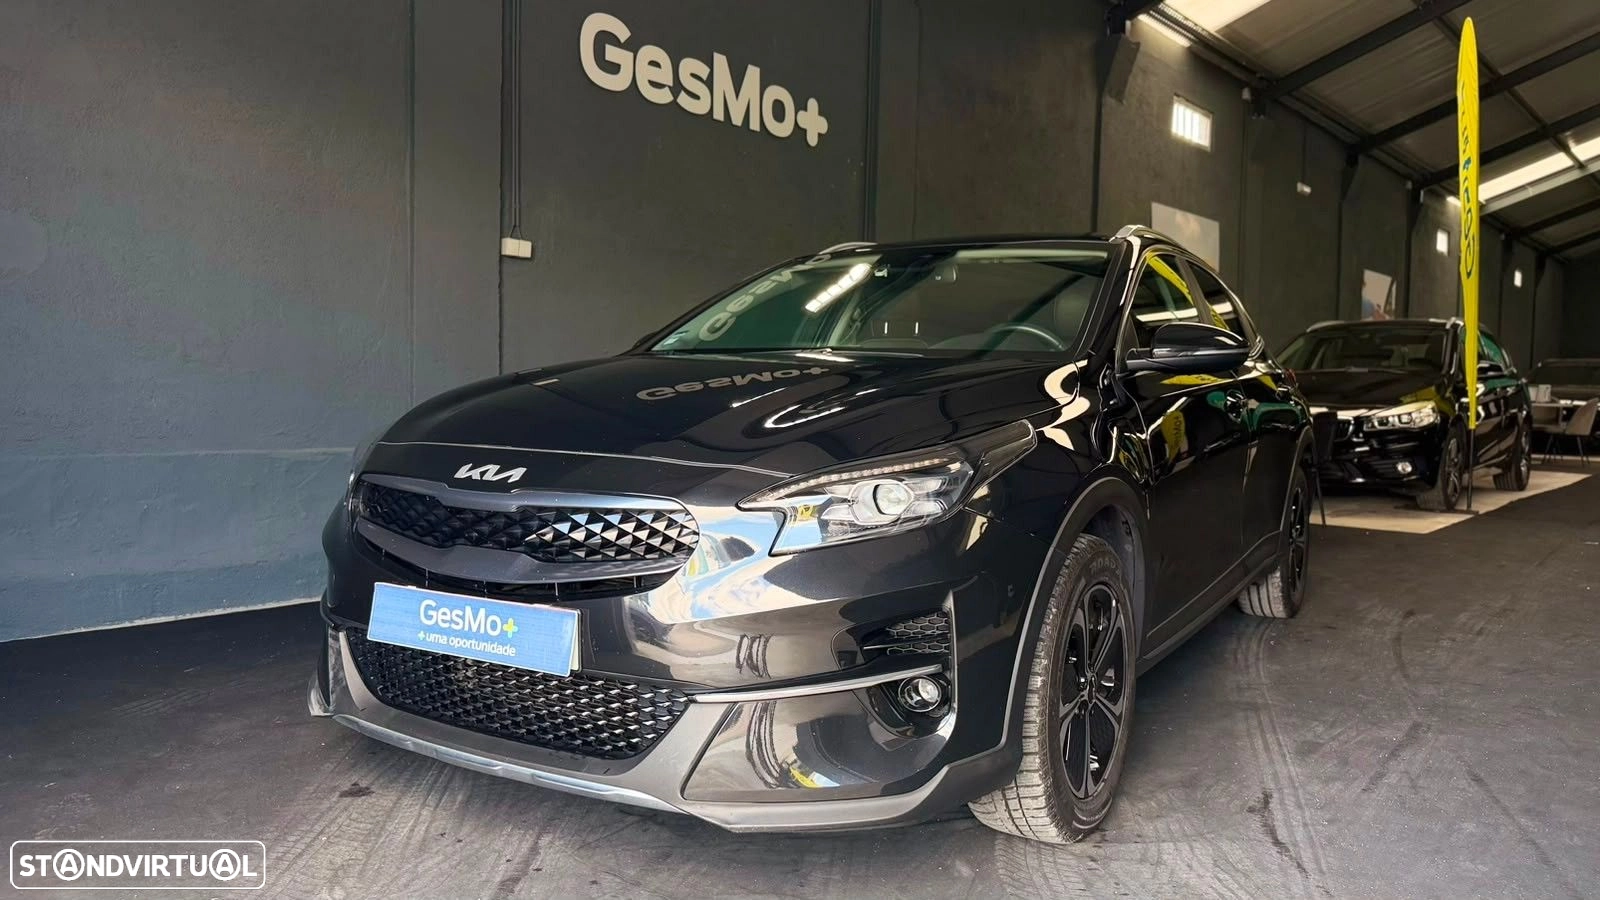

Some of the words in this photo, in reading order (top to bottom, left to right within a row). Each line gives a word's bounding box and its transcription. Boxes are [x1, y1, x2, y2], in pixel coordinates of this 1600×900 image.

[579, 12, 828, 147] GesMo+
[453, 463, 528, 483] KIA
[419, 599, 518, 638] GesMo+
[449, 635, 516, 657] oportunidade
